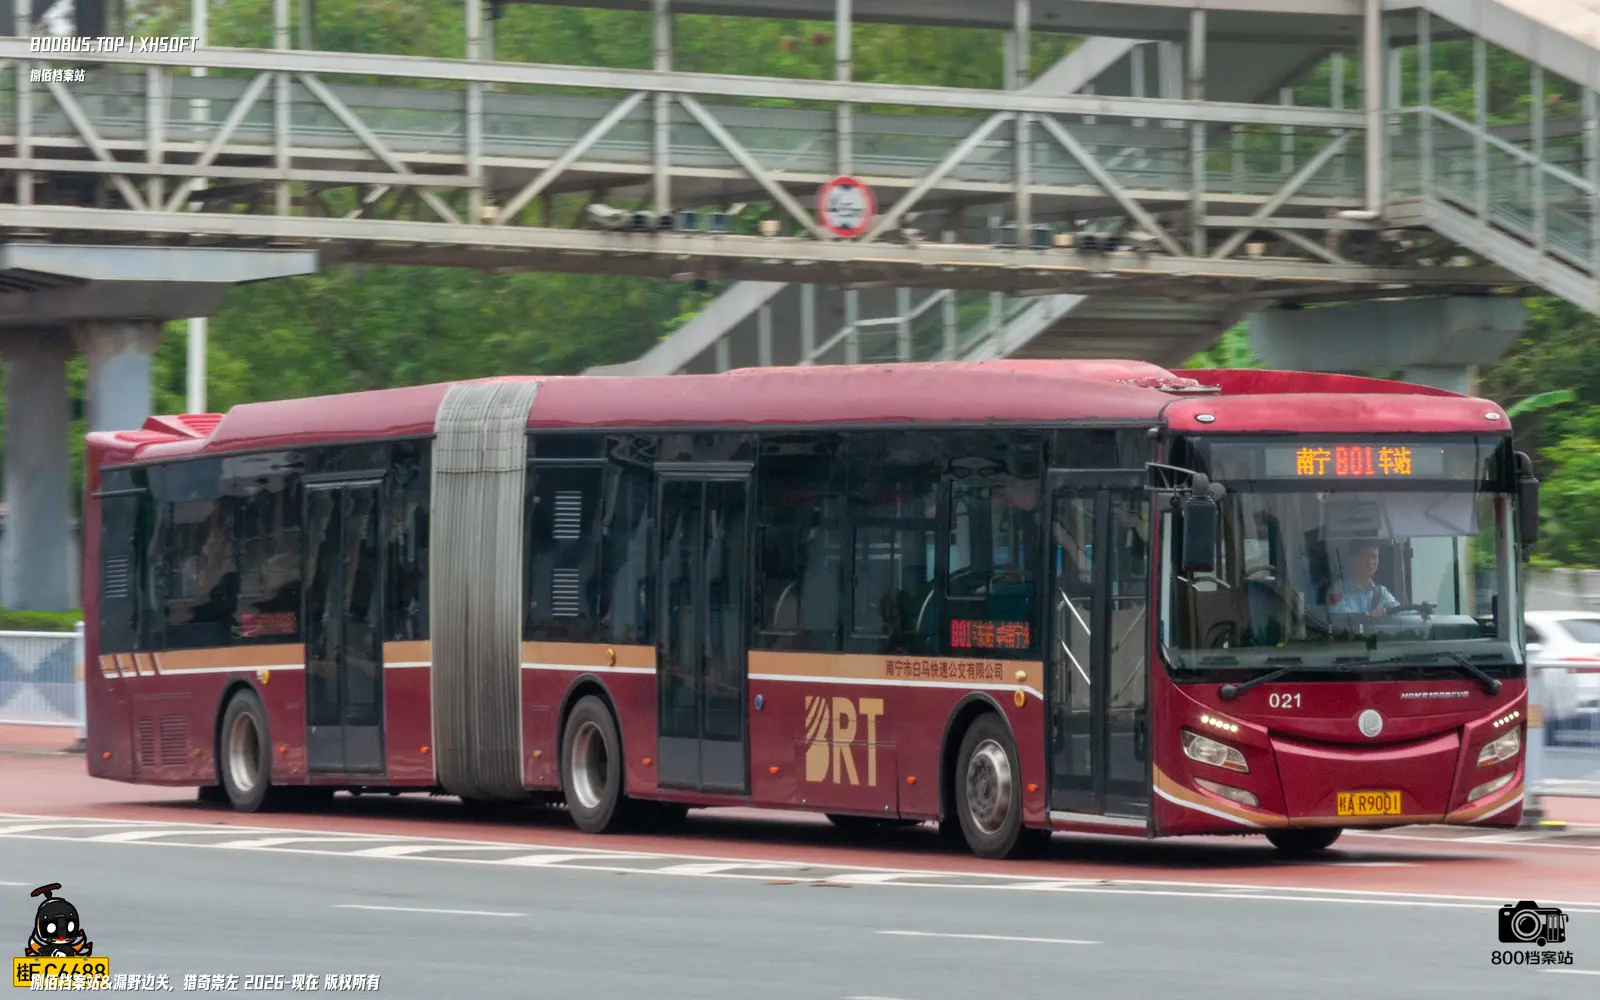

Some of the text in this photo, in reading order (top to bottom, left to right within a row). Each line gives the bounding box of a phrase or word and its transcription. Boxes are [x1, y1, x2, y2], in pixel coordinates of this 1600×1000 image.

[1296, 447, 1331, 475] 南宁
[1378, 447, 1412, 475] 车站
[886, 660, 1003, 680] 南宁市白马快速公交有限公司
[1269, 693, 1301, 708] 021
[805, 696, 884, 787] BRT
